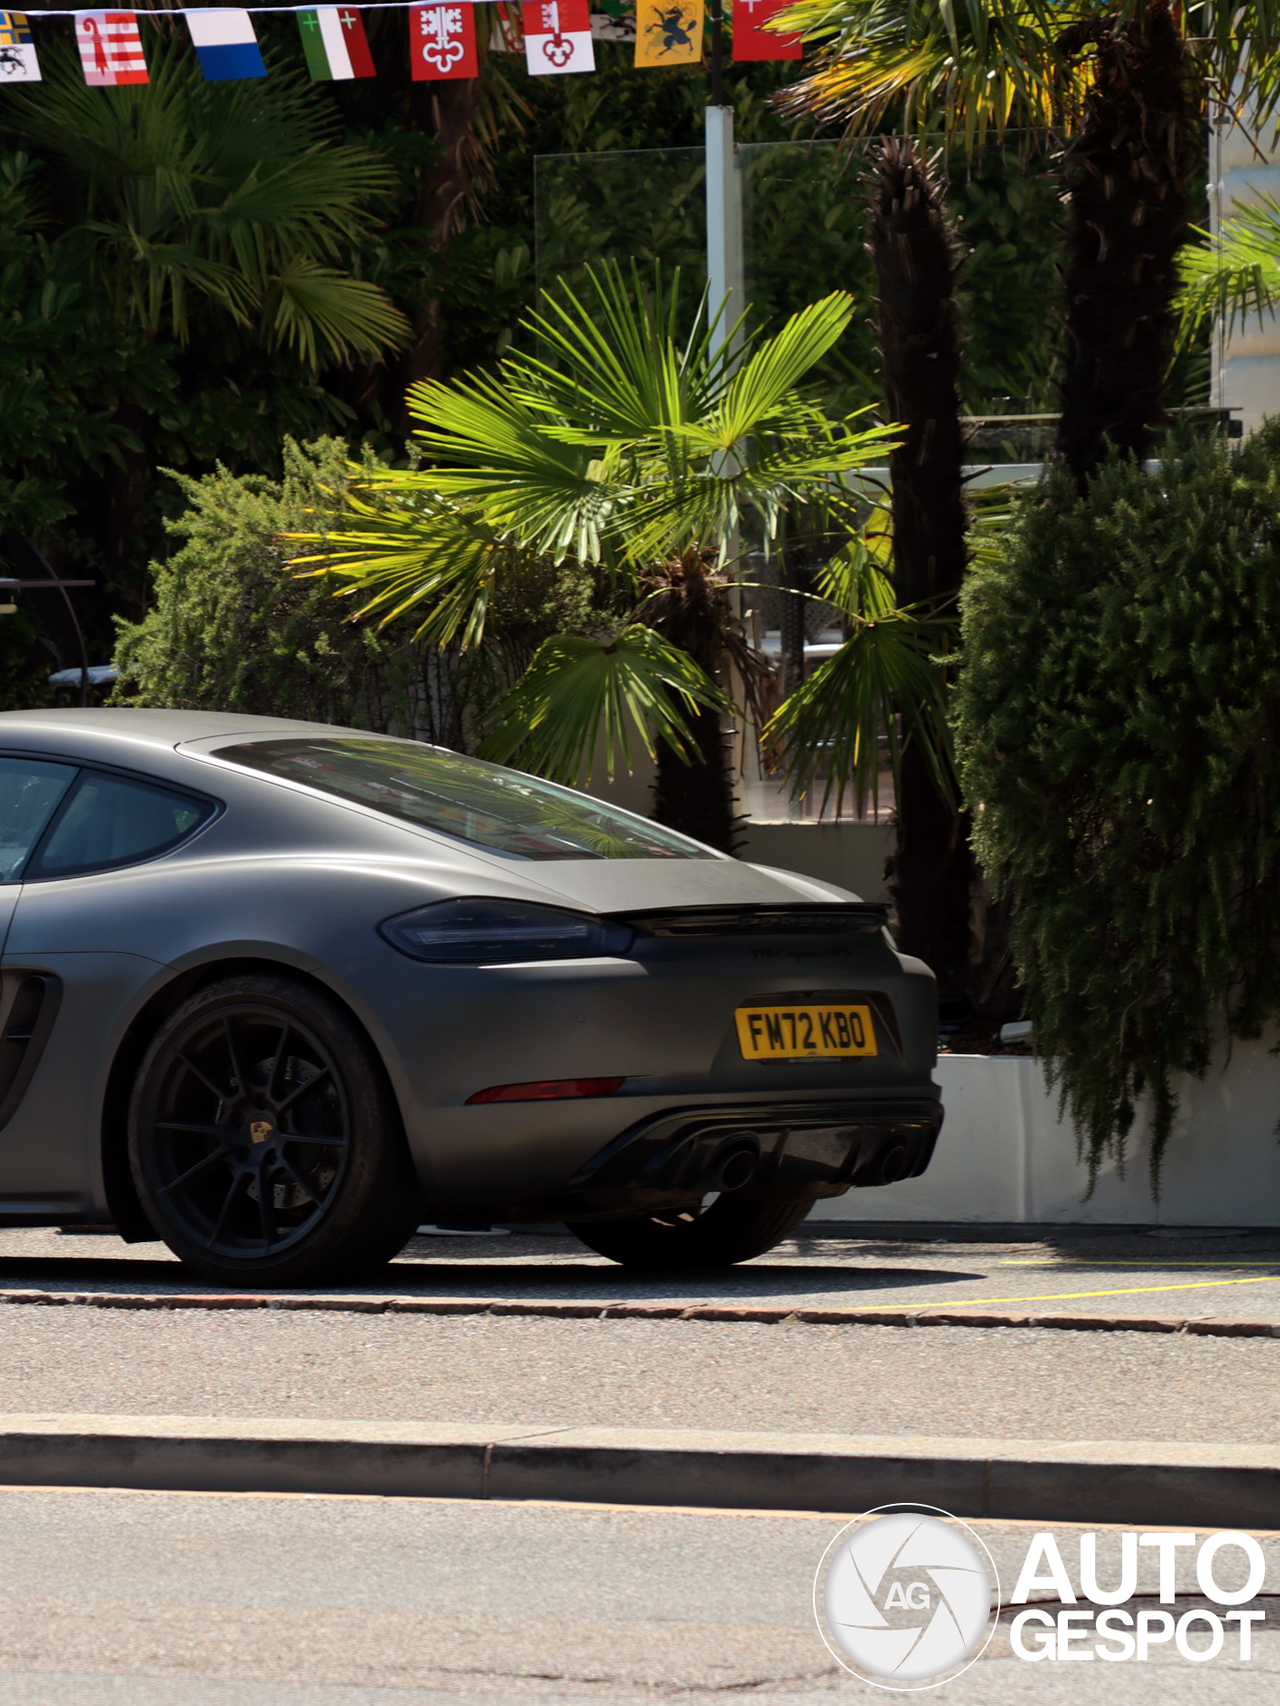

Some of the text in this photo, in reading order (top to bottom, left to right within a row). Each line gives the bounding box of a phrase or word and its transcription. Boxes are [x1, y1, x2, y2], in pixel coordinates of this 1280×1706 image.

[738, 914, 858, 928] PORSCHE
[747, 1011, 866, 1051] FM72 KBO
